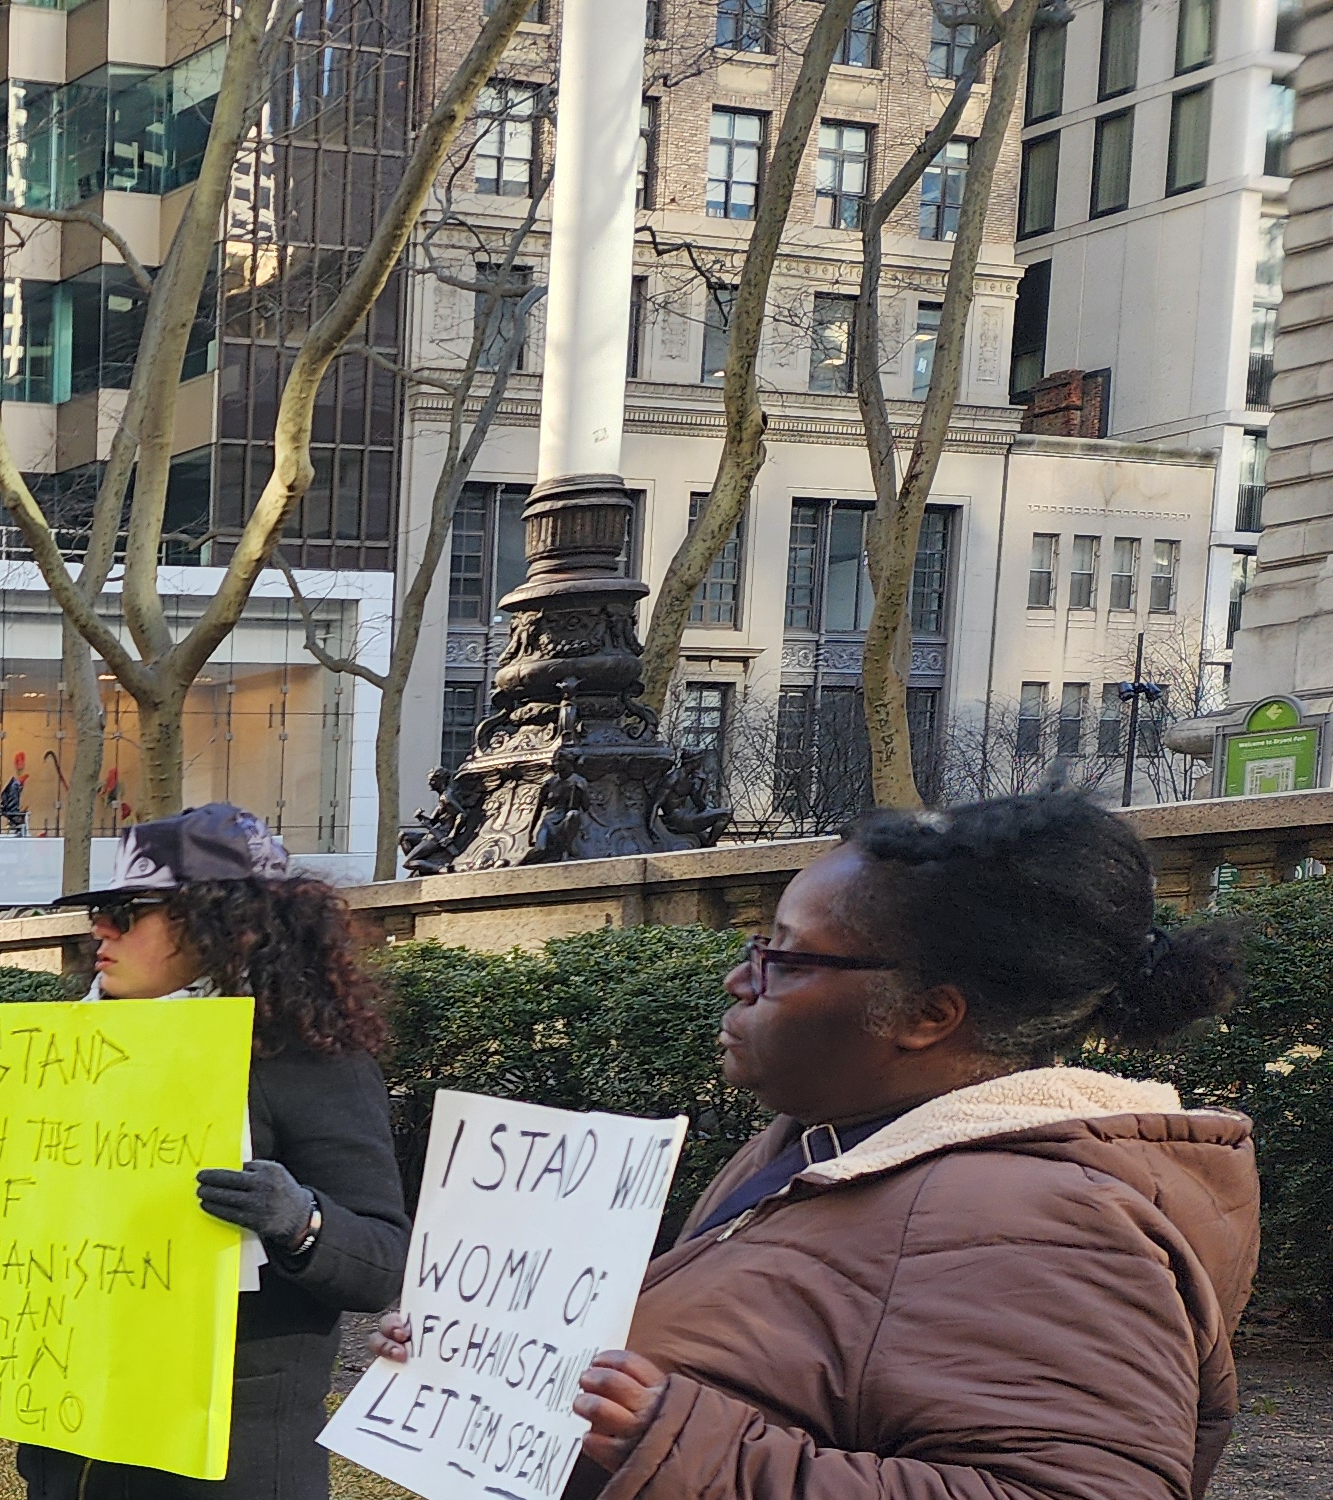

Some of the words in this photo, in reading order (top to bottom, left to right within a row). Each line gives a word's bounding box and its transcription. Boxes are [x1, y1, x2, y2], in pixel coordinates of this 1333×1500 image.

[25, 1116, 85, 1167] THE
[93, 1120, 213, 1171] WOMEN
[440, 1119, 466, 1189] I
[472, 1122, 598, 1199] STAD
[562, 1266, 608, 1328] OF
[364, 1371, 460, 1439] LET
